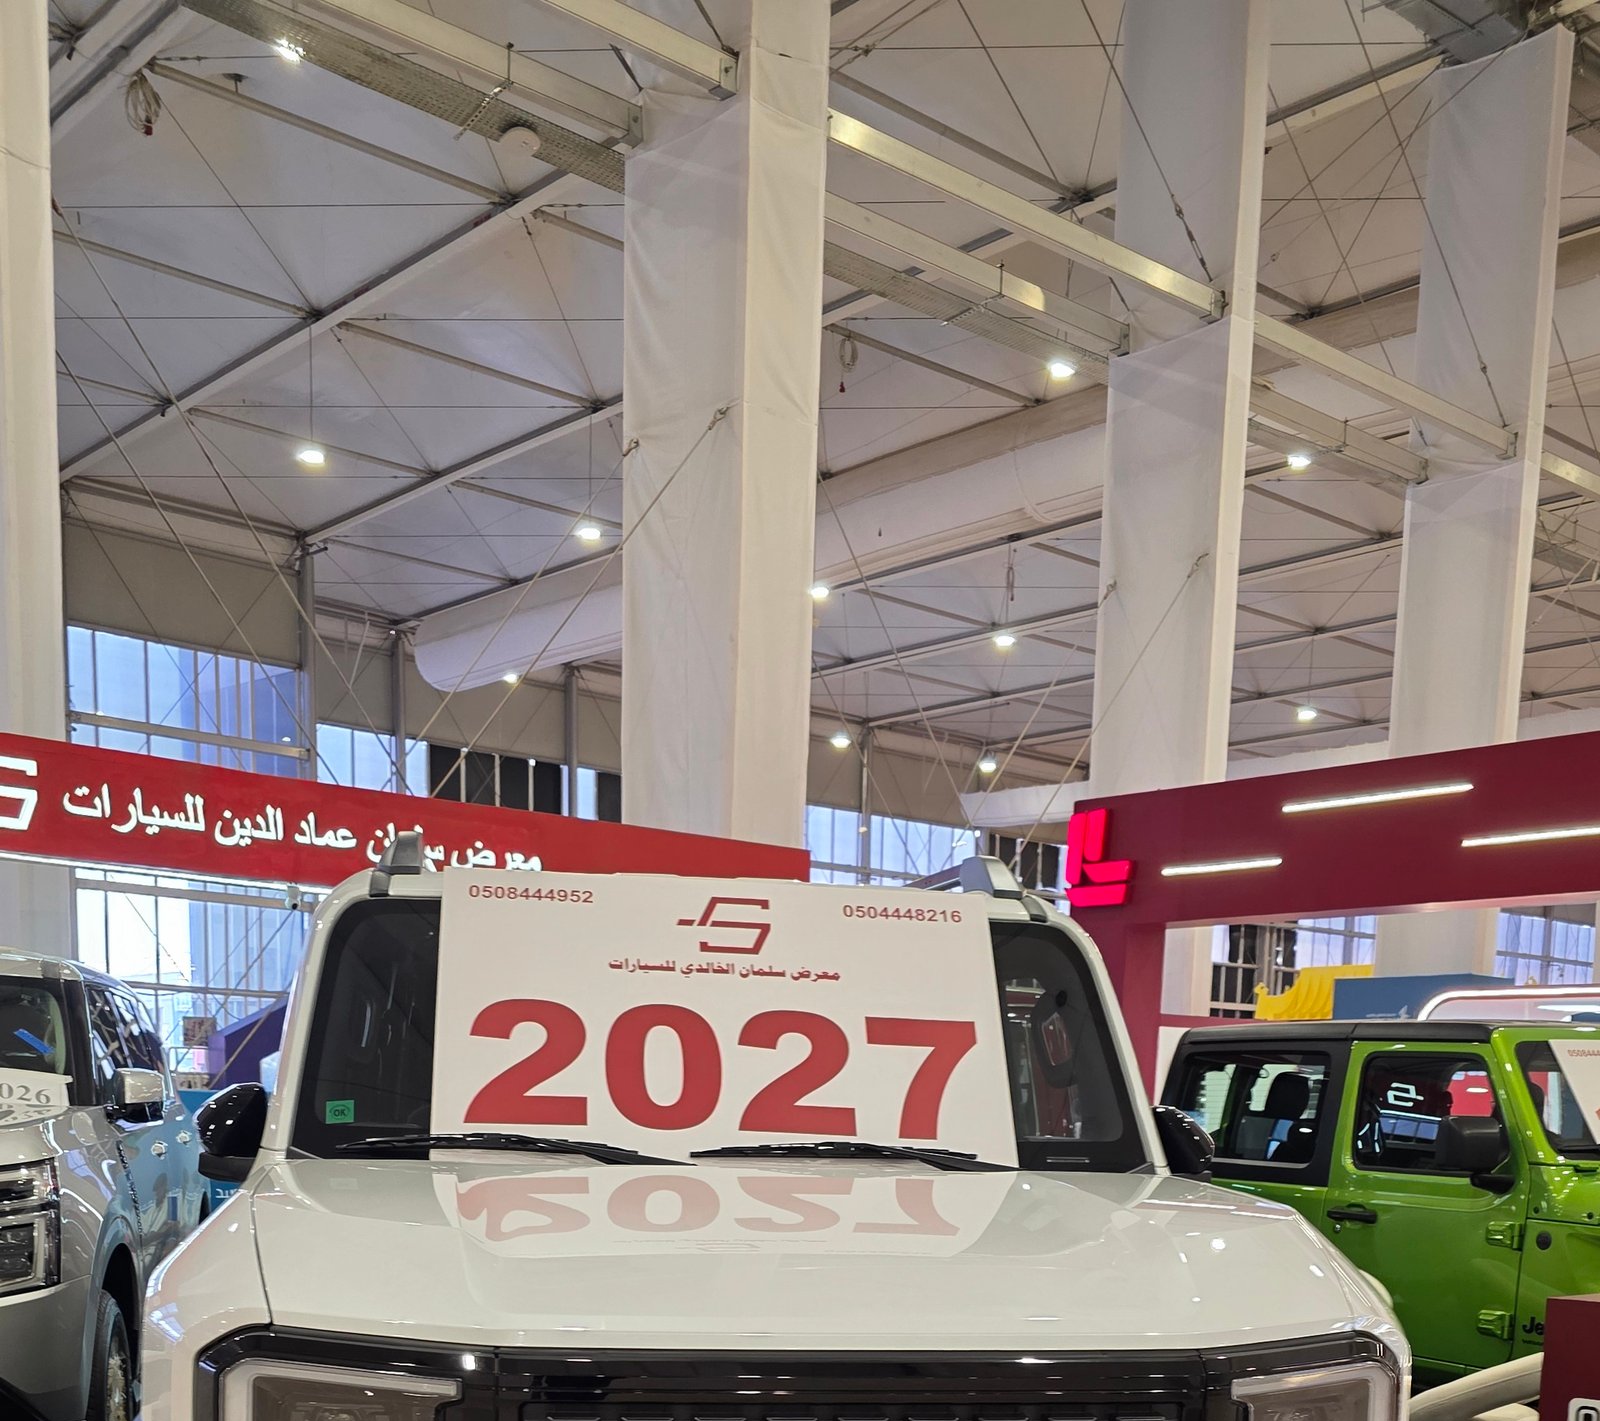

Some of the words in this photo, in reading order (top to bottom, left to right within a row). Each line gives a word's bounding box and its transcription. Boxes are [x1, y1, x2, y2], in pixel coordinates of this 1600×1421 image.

[63, 782, 206, 835] للسيارات
[214, 803, 284, 847] الدين
[294, 811, 357, 848] عماد
[366, 822, 445, 864] سان
[450, 840, 543, 872] معرض
[469, 885, 594, 904] 0508444952
[843, 904, 962, 923] 0504448216
[608, 957, 677, 974] للسيارات
[680, 961, 735, 979] الخالدي
[739, 963, 787, 979] سلمان
[791, 966, 841, 983] معرض
[1567, 1049, 1600, 1058] 0508444
[463, 998, 978, 1141] 2027
[0, 1082, 52, 1105] 026
[333, 1108, 347, 1118] OK
[1522, 1316, 1545, 1336] Je
